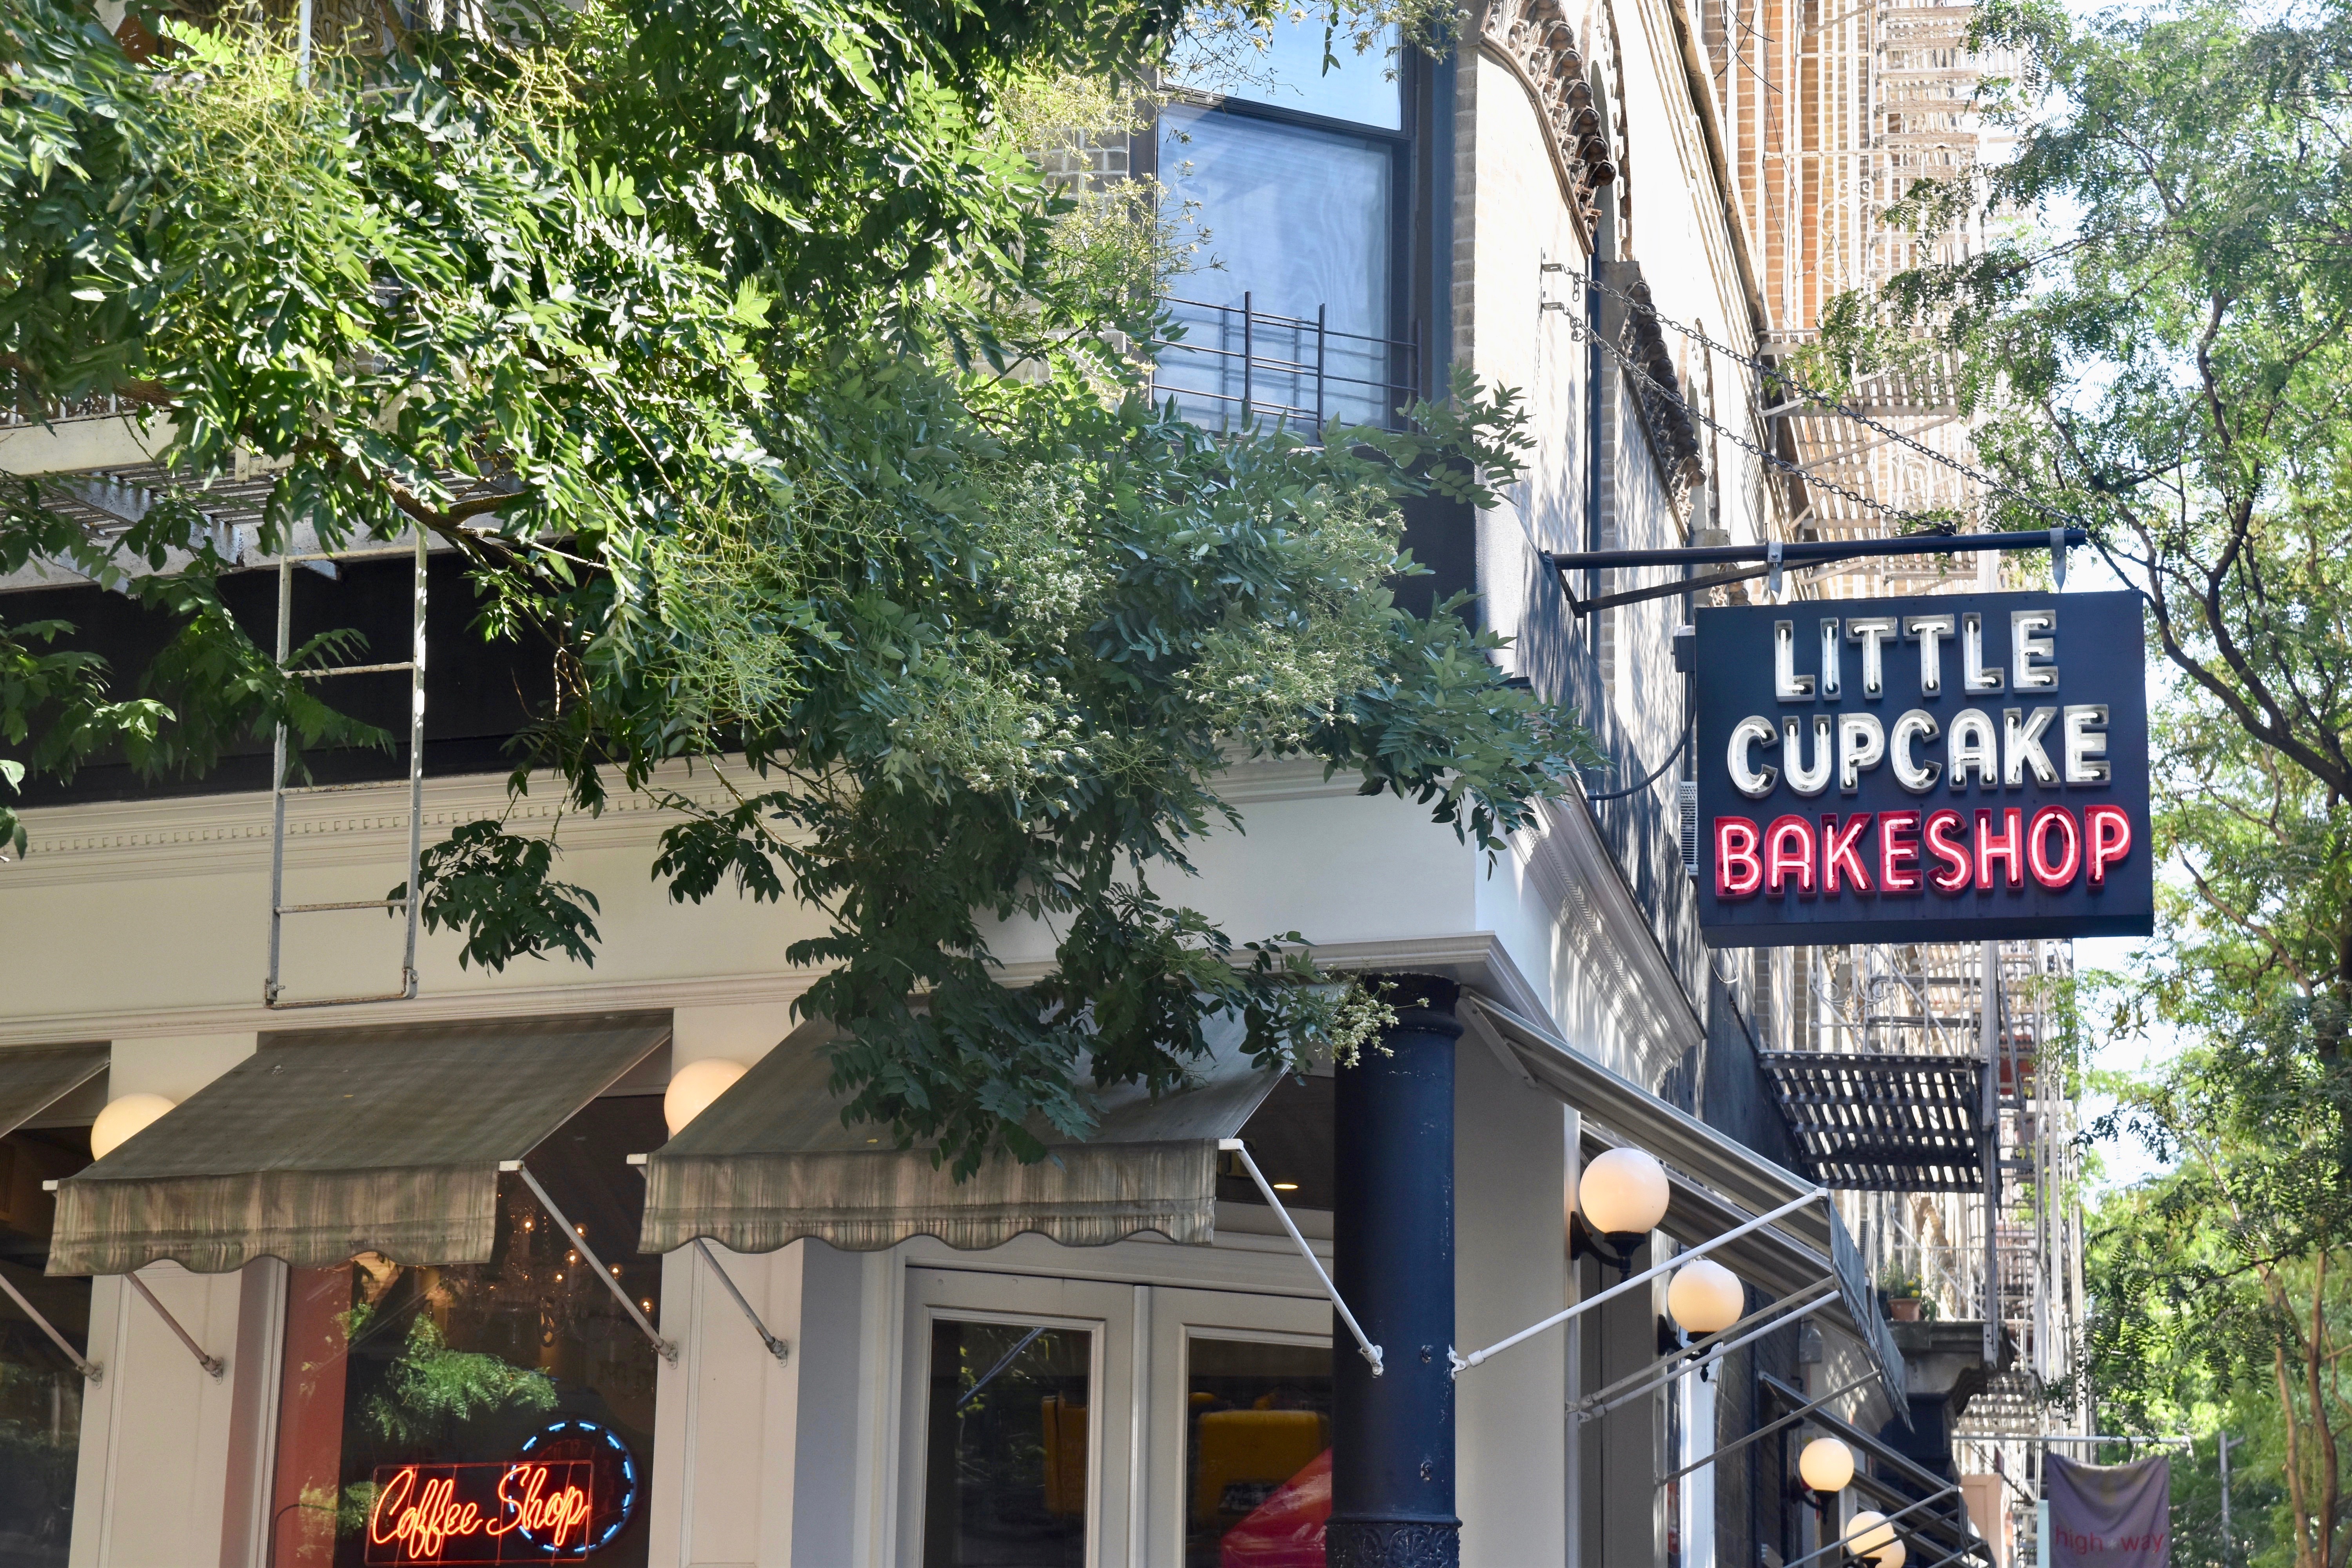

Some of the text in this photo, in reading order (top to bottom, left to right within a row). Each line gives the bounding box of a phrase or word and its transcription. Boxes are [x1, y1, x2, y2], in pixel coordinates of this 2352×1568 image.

[1775, 610, 2058, 702] LITTLE
[1727, 704, 2111, 799] CUPCAKE
[1714, 805, 2131, 900] BAKESHOP
[372, 1467, 483, 1558] Coffee
[486, 1466, 590, 1546] Shop
[2055, 1525, 2164, 1555] high way
